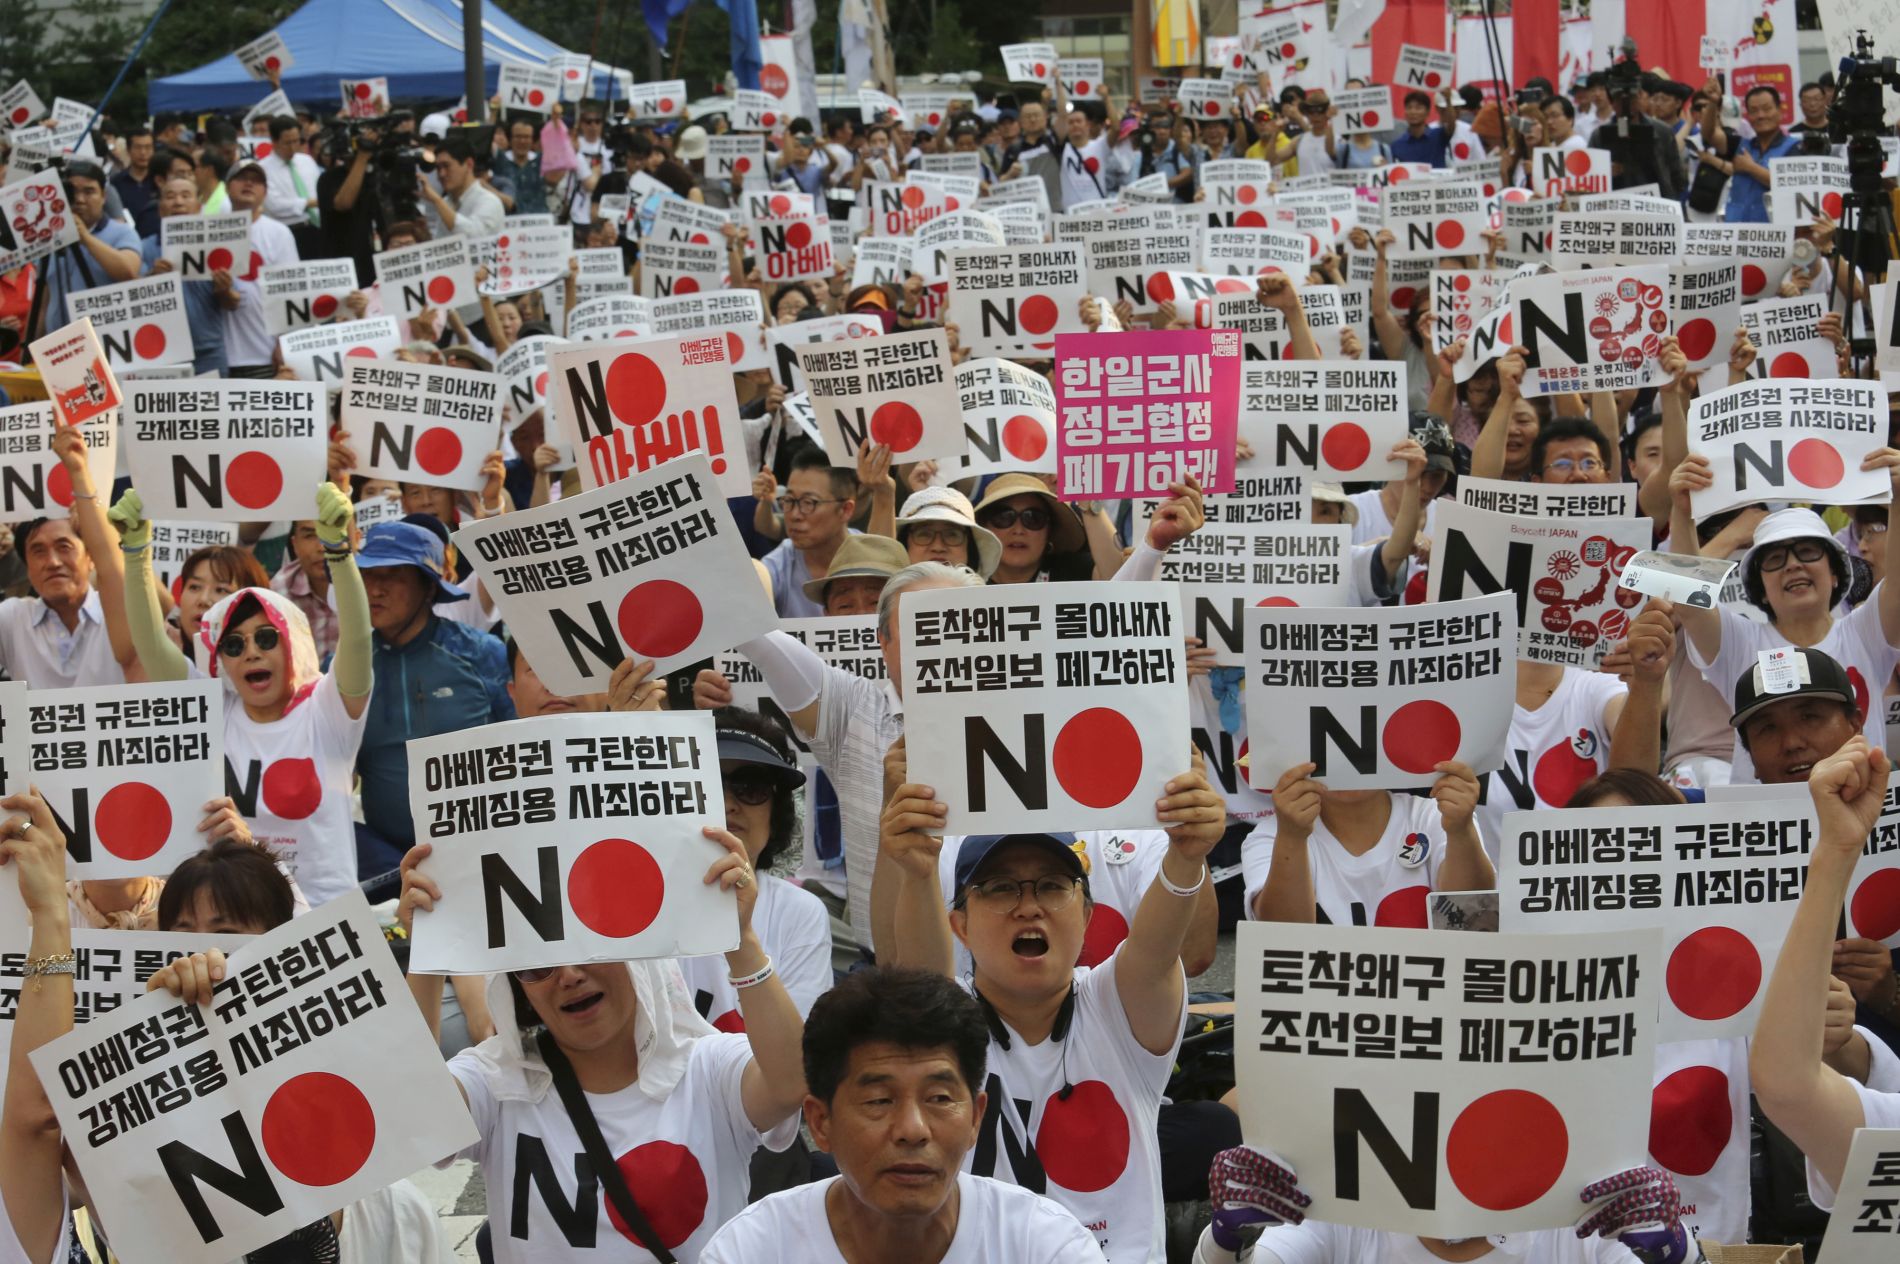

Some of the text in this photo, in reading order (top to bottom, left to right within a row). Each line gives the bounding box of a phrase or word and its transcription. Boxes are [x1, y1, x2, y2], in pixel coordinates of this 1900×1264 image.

[1435, 188, 1478, 200] 몰아내자
[1558, 218, 1676, 238] 토착왜구 몰아내자
[1737, 229, 1786, 244] 몰아내자
[767, 242, 832, 279] 아베!
[954, 251, 1076, 270] 토착왜구 몰아내자
[1092, 236, 1190, 254] 아베정권 규탄한다
[1094, 252, 1191, 270] 강제징용 사죄하라
[1558, 238, 1677, 256] 조선일보 폐간하라
[956, 270, 1078, 290] 조선일보 폐간하라
[1683, 265, 1736, 290] 몰아내자
[74, 281, 175, 313] 토착왜구 몰아내자
[653, 296, 755, 318] 아베정권 규탄한다
[1681, 287, 1736, 310] 폐간하라
[1764, 303, 1822, 323] 규탄한다
[656, 311, 758, 332] 강제징용 사죄하라
[803, 340, 938, 373] 아베정권 규탄한다
[352, 367, 497, 400] 토착왜구 몰아내자
[810, 364, 943, 396] 강제징용 사죄하라
[1061, 353, 1212, 400] 한일군사
[1246, 371, 1397, 388] 토착왜구 몰아내자
[134, 390, 220, 414] 아베정권
[228, 391, 313, 412] 규탄한다
[350, 391, 494, 423] 조선일보 폐간하라
[1247, 394, 1398, 412] 조선일보 폐간하라
[1700, 385, 1876, 419] 아베정권 규탄한다
[136, 417, 313, 441] 강제징용 사죄하라
[1062, 401, 1212, 447] 정보협정
[1700, 410, 1876, 442] 강제징용 사죄하라
[1062, 449, 1219, 496] 폐기하라!
[474, 472, 703, 562] 아베정권 규탄한다
[1226, 501, 1301, 524] 폐간하라
[1254, 536, 1340, 557] 몰아내자
[1511, 524, 1578, 538] Boycott JAPAN
[492, 508, 718, 596] 강제징용 사죄하라
[1161, 562, 1339, 584] 조선일보 폐간하라
[915, 601, 1171, 647] 토착왜구 몰아내자
[1260, 612, 1501, 651] 아베정권 규탄한다
[1527, 646, 1584, 665] 해야한다!
[1529, 632, 1587, 650] 못했지만,
[916, 647, 1175, 694] 조선일보 폐간하라
[1262, 648, 1501, 687] 강제징용 사죄하라
[95, 696, 208, 730] 규탄한다
[97, 732, 210, 767] 사죄하라
[424, 738, 554, 792] 아베정권
[565, 735, 701, 772] 규탄한다
[427, 780, 707, 838] 강제징용 사죄하라
[1518, 819, 1812, 867] 아베정권 규탄한다
[1518, 866, 1809, 914] 강제징용 사죄하라
[1260, 949, 1640, 1004] 토착왜구 몰아내자
[58, 919, 364, 1099] 아베정권 규탄한다
[1258, 1009, 1637, 1063] 조선일보 폐간하라
[78, 968, 389, 1150] 강제징용 사죄하라
